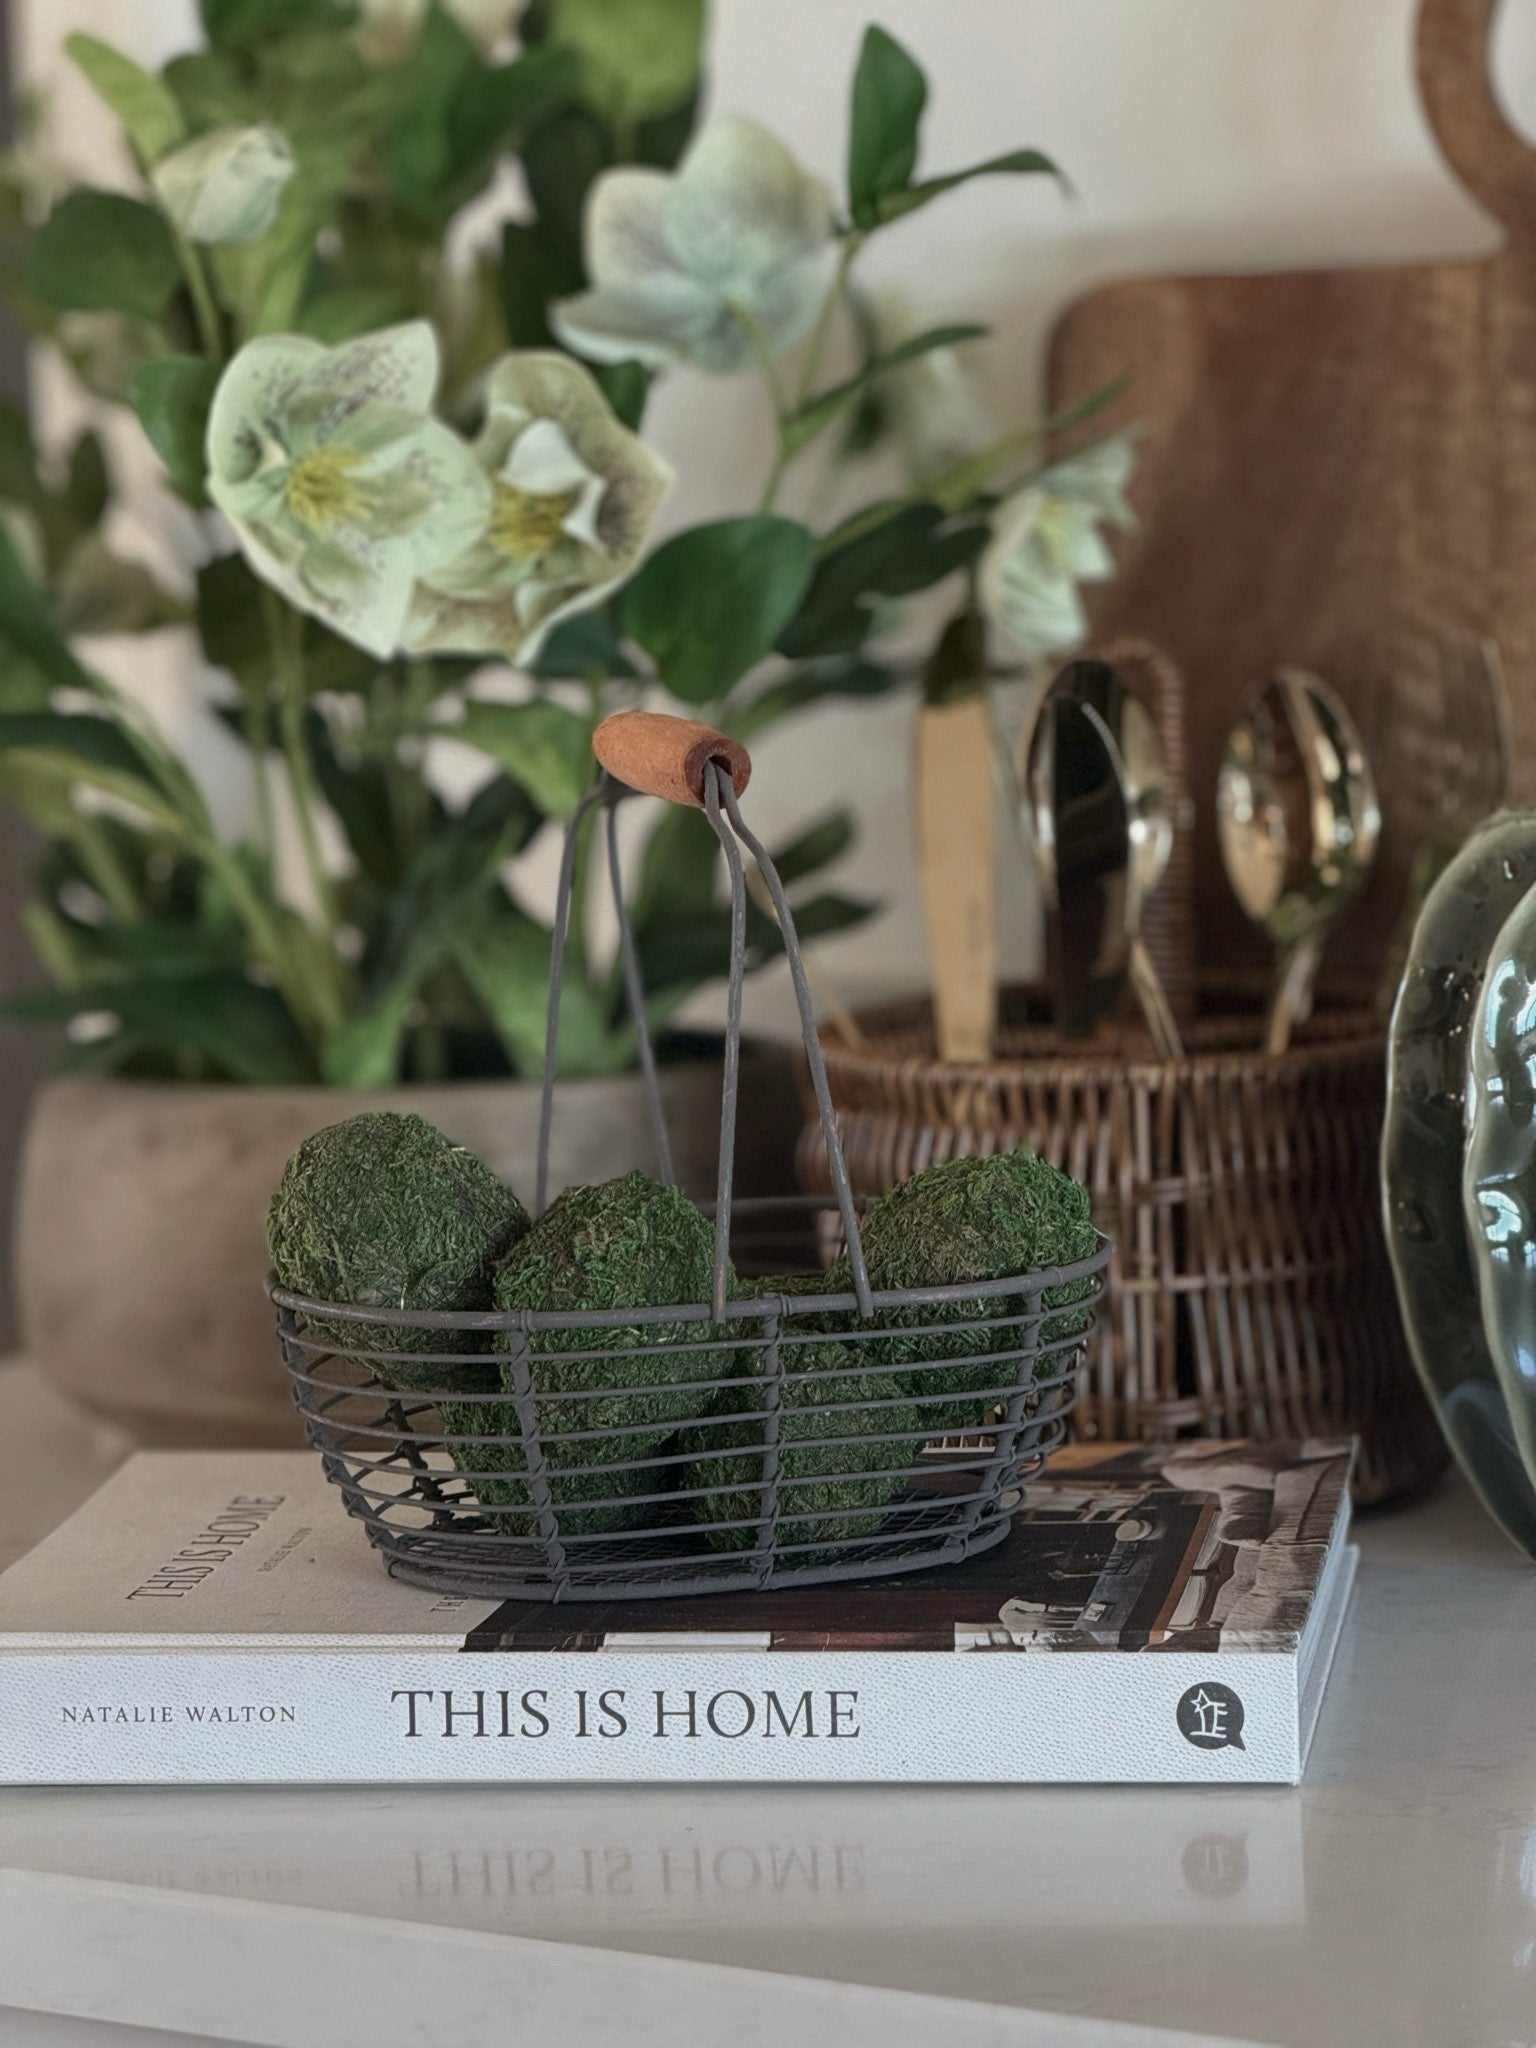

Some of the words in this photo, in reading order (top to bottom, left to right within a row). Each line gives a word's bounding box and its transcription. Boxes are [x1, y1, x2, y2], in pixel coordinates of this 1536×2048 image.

[190, 1496, 286, 1545] HOME
[172, 1549, 233, 1562] IS
[126, 1566, 214, 1600] THIS
[62, 1706, 174, 1723] NATALIE
[186, 1706, 297, 1723] WALTON
[391, 1689, 550, 1738] THIS
[574, 1689, 628, 1738] IS
[652, 1689, 861, 1738] HOME
